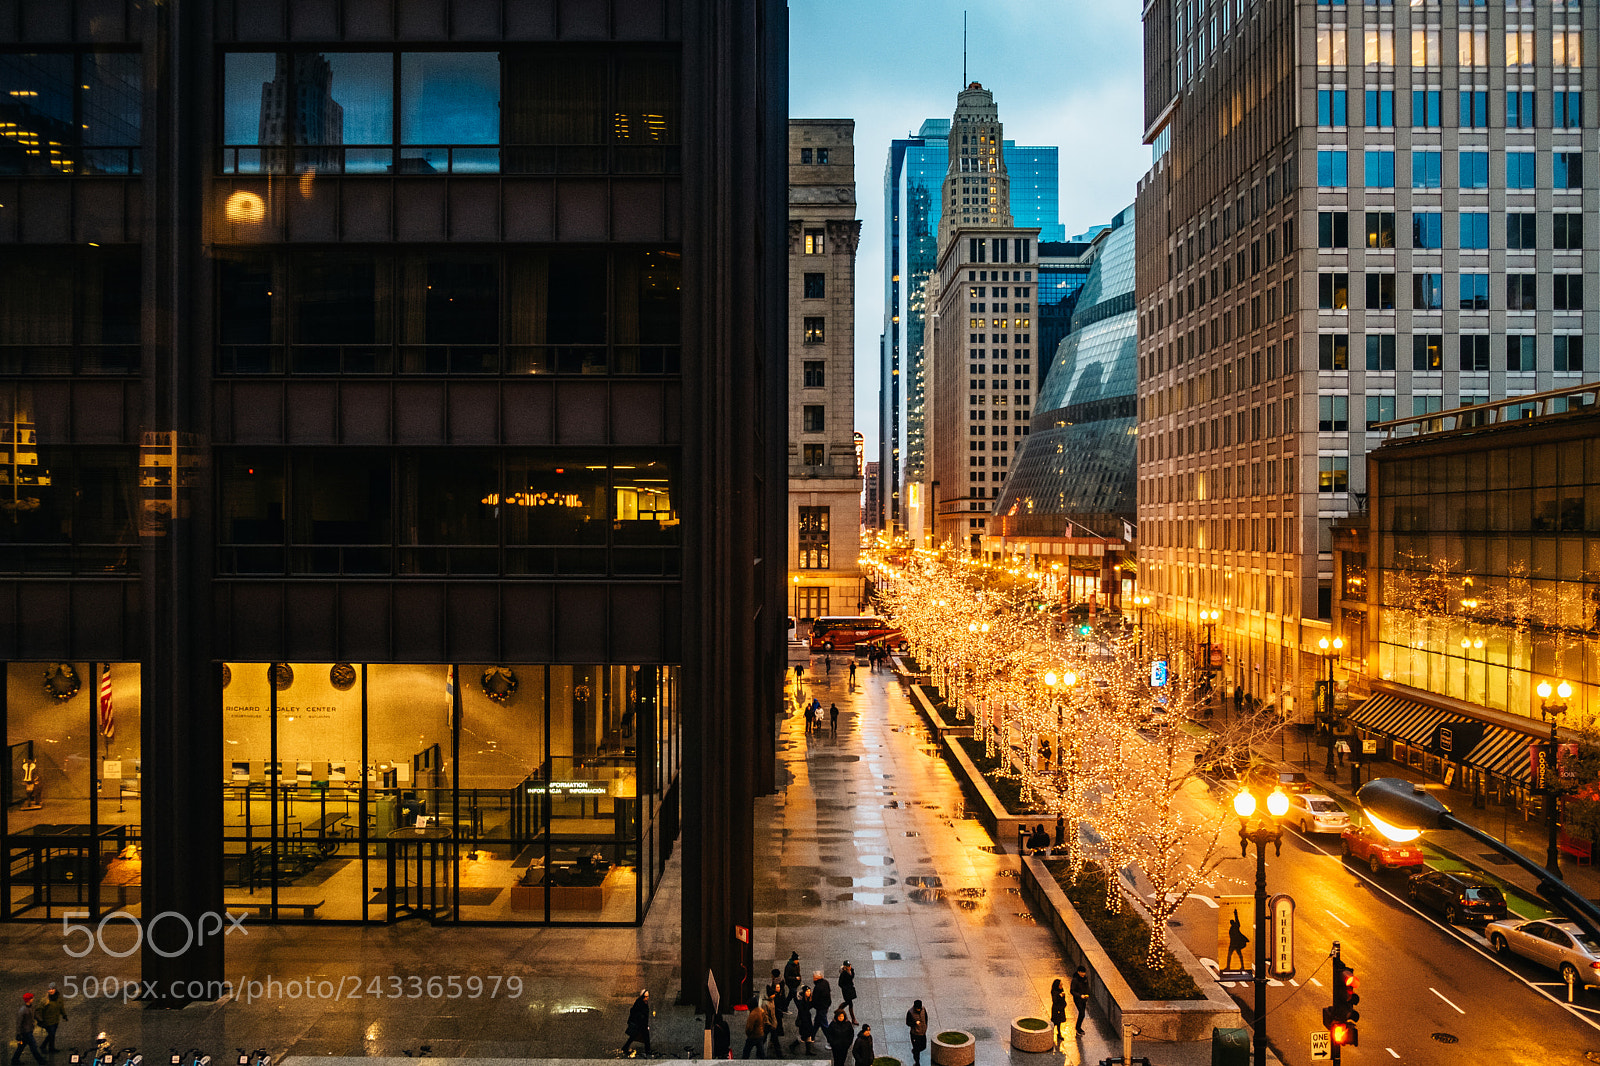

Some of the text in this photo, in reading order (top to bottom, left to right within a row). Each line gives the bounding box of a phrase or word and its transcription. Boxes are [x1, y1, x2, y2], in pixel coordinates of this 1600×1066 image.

[1538, 751, 1546, 789] GOODMAN
[1312, 1033, 1329, 1041] ONE
[1312, 1041, 1329, 1049] WAY
